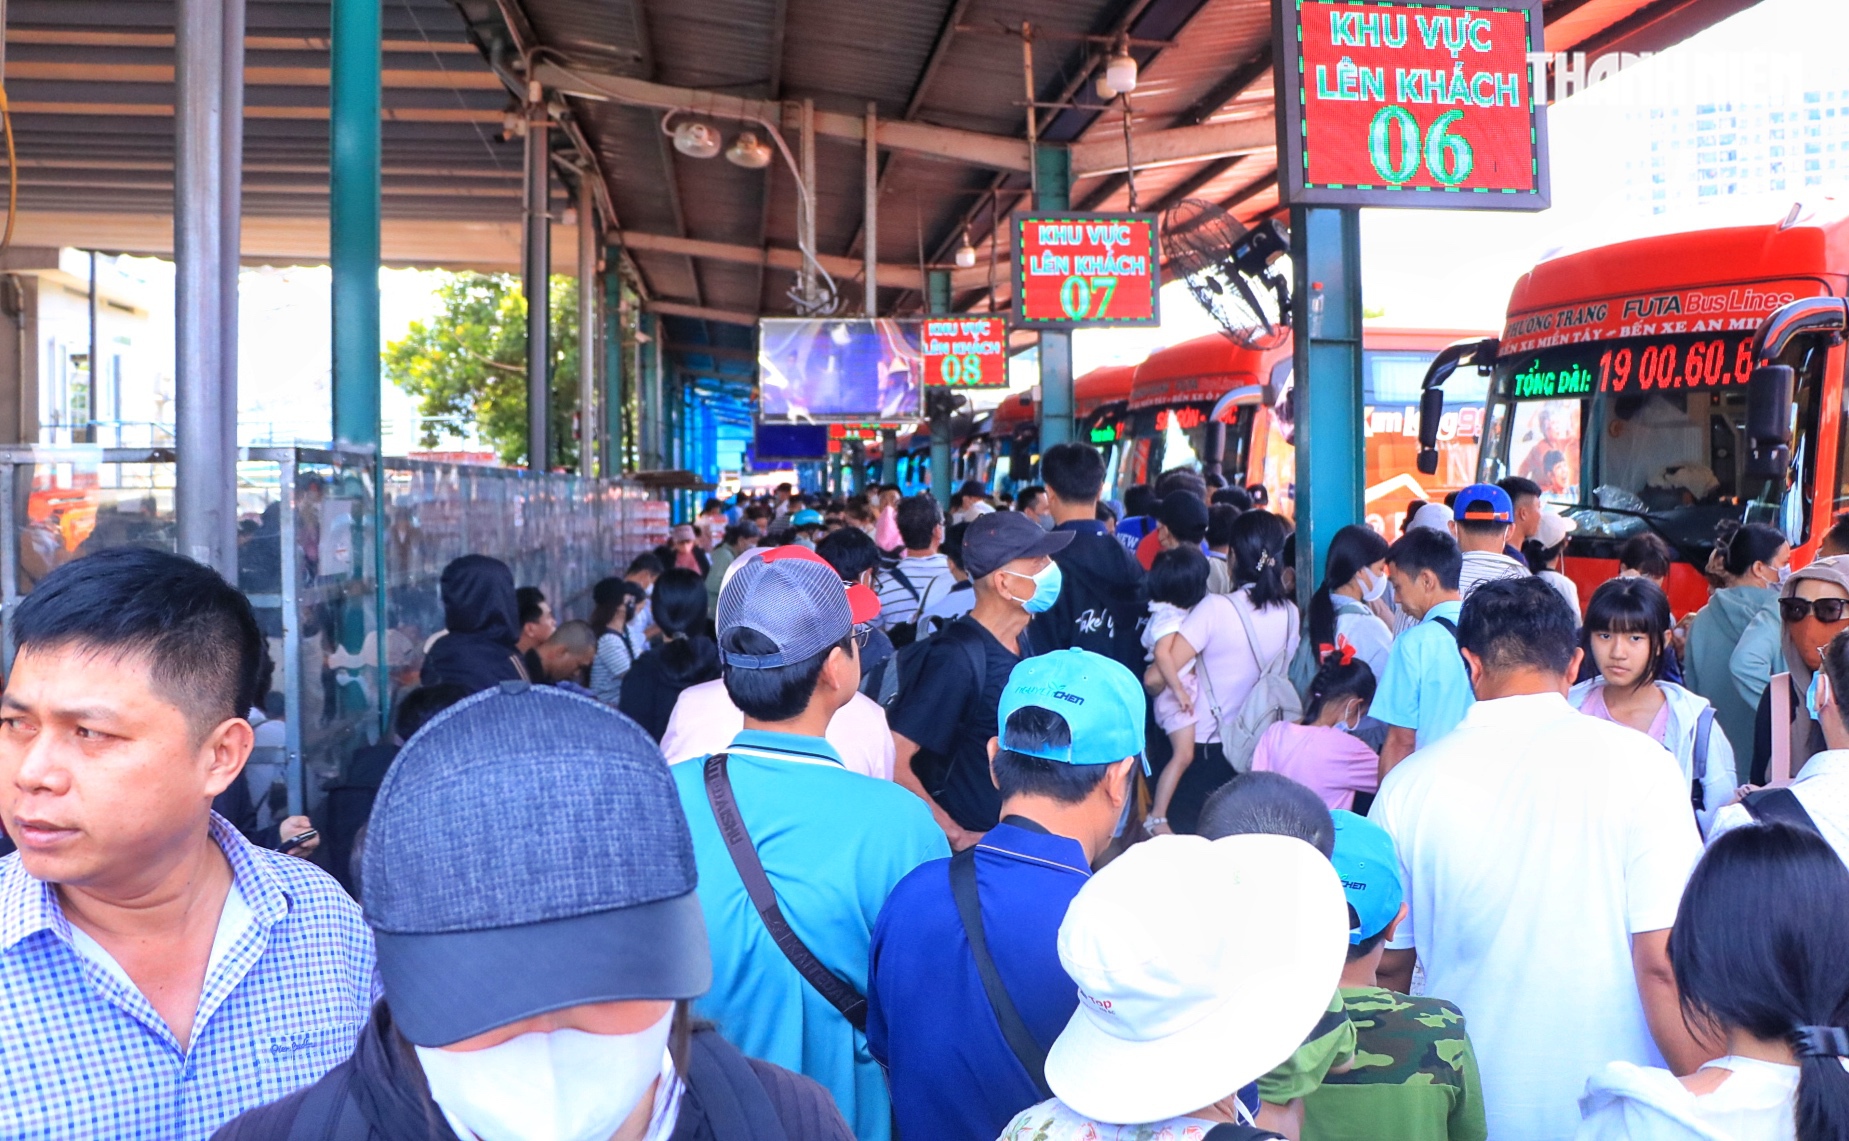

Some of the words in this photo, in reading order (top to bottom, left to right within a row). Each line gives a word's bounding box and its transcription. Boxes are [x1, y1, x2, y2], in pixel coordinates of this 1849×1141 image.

[1330, 11, 1407, 48] KHU
[1415, 12, 1491, 58] VỰC
[1316, 56, 1385, 101] LÊN
[1396, 61, 1519, 107] KHÁCH
[1368, 105, 1473, 185] 06
[1038, 225, 1082, 245] KHU
[1086, 223, 1130, 250] VỰC
[1030, 249, 1069, 275] LÊN
[1074, 250, 1145, 275] KHÁCH
[1060, 275, 1118, 320] 07
[1621, 295, 1682, 319] FUTA
[1684, 292, 1726, 315] Bus
[1727, 289, 1794, 312] Lines
[928, 322, 958, 337] KHU
[960, 320, 991, 341] VỰC
[1555, 304, 1608, 328] TRANG
[923, 338, 950, 355] LÊN
[1519, 338, 1536, 352] XE
[1619, 319, 1656, 338] BẾN
[1660, 321, 1687, 334] XE
[1693, 318, 1724, 333] AN
[941, 354, 982, 386] 08
[1515, 359, 1555, 397] TỔNG
[1638, 337, 1769, 389] 00.60.6
